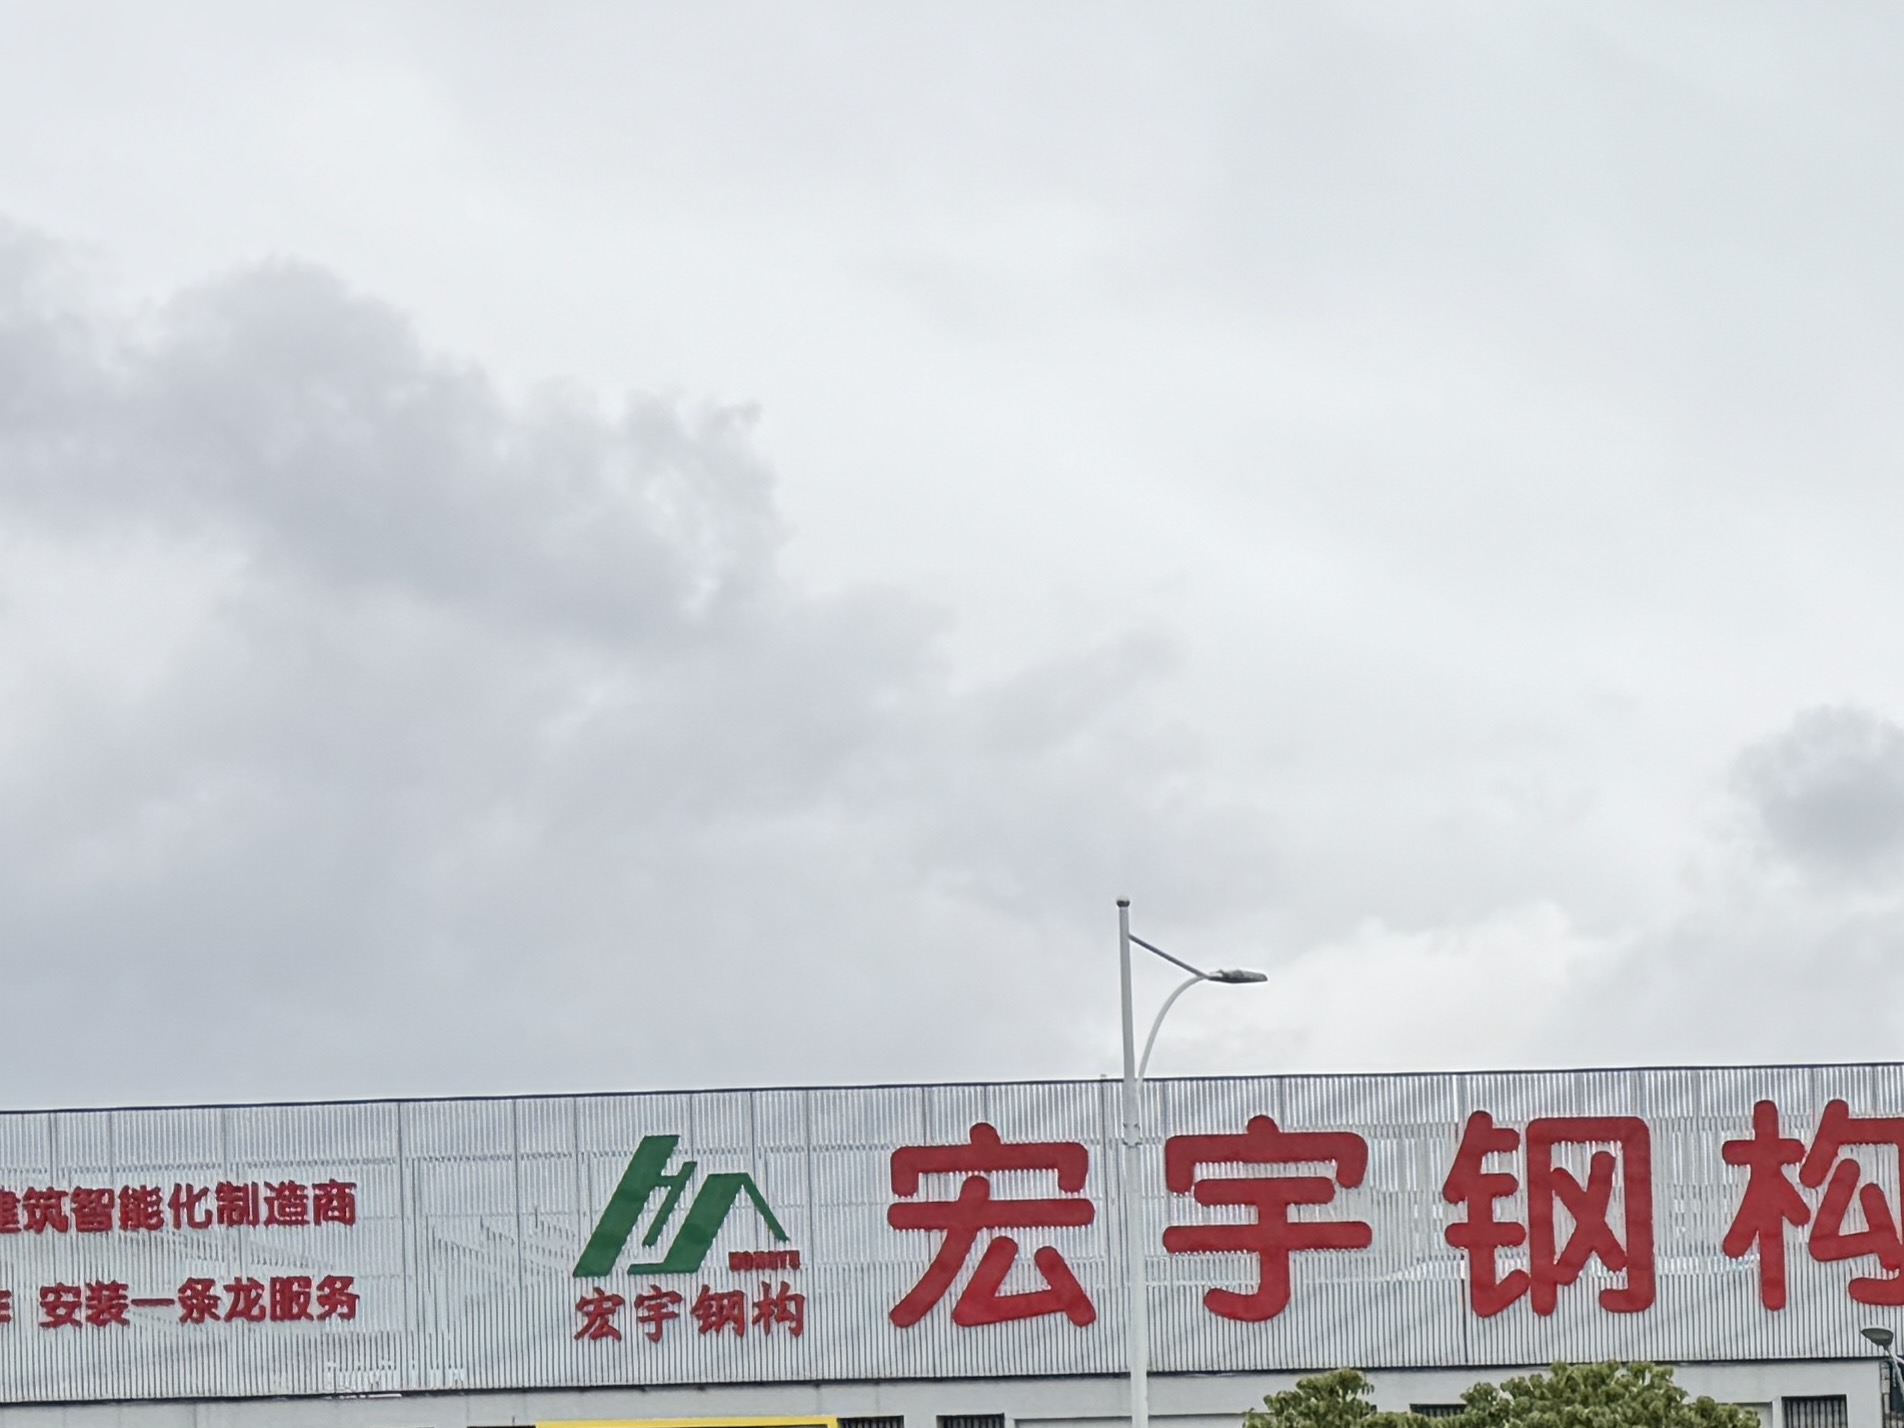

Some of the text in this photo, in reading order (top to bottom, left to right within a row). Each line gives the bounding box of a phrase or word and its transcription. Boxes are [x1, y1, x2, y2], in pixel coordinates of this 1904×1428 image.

[39, 1275, 359, 1328] 安装一条龙服务
[574, 1284, 805, 1343] 宏宇钢构
